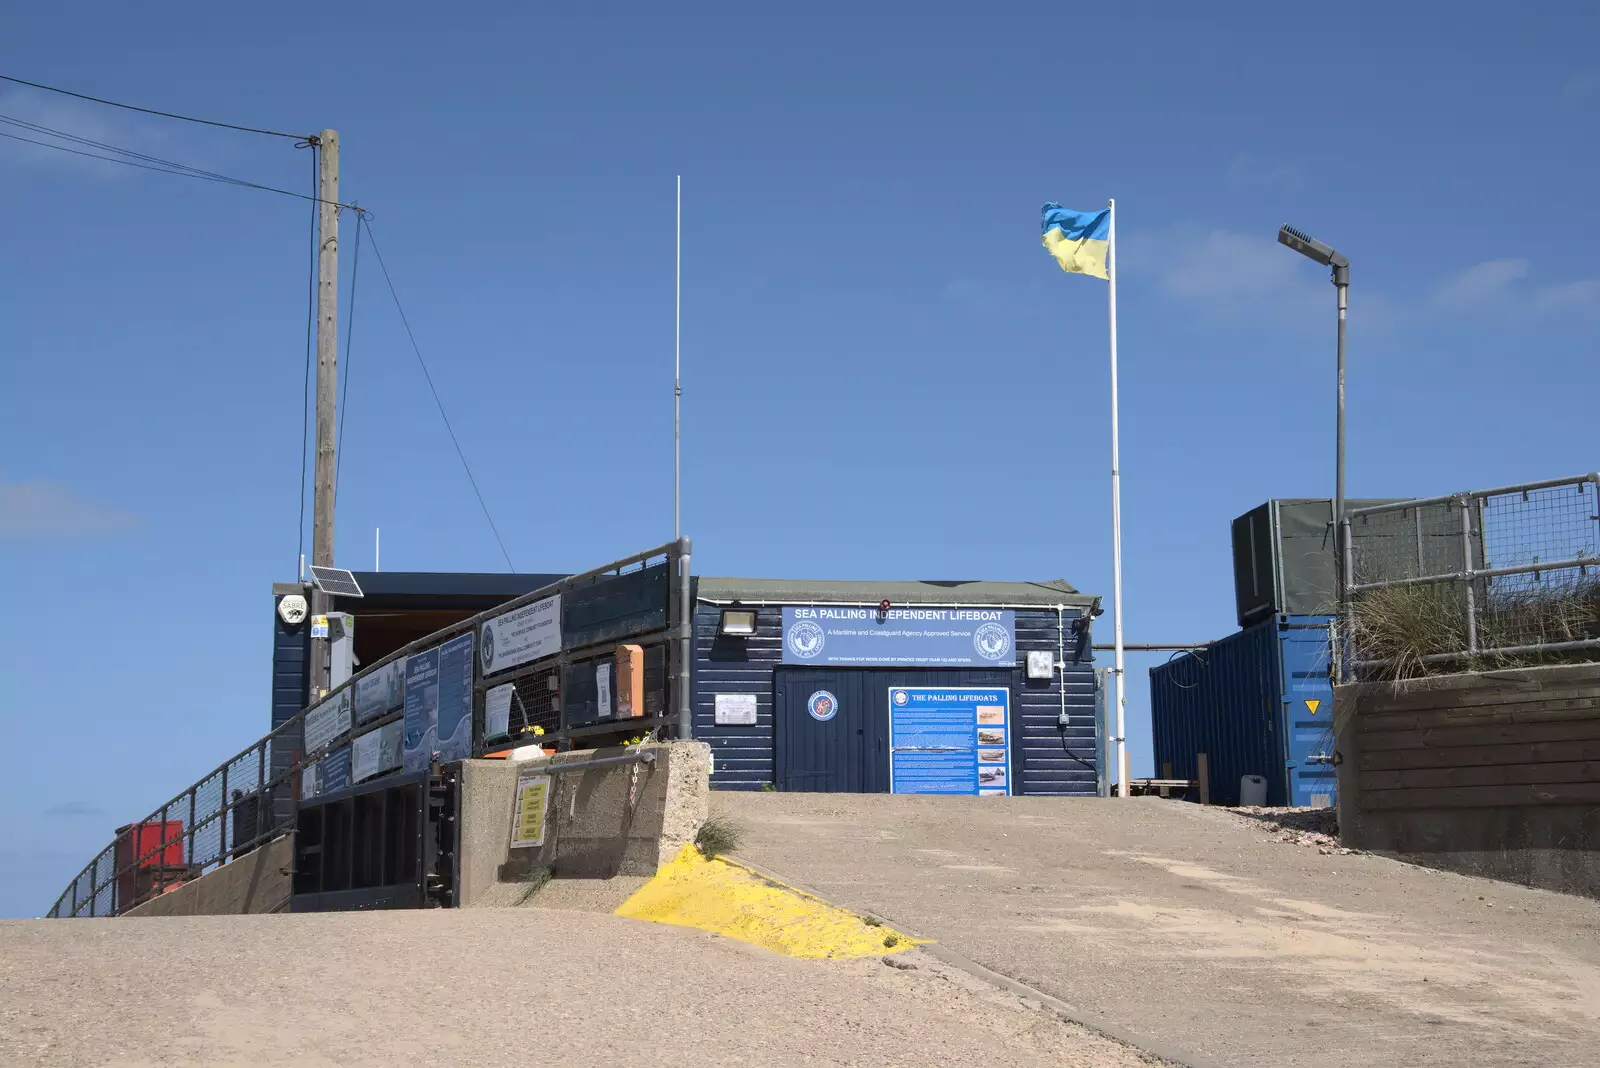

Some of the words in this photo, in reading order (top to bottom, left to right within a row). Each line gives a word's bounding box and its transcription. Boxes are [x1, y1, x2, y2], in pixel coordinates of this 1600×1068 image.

[794, 609, 817, 618] SEA
[820, 610, 866, 619] PALLING
[870, 610, 947, 620] INDEPENDENT
[950, 611, 1002, 620] LIFEBOAT
